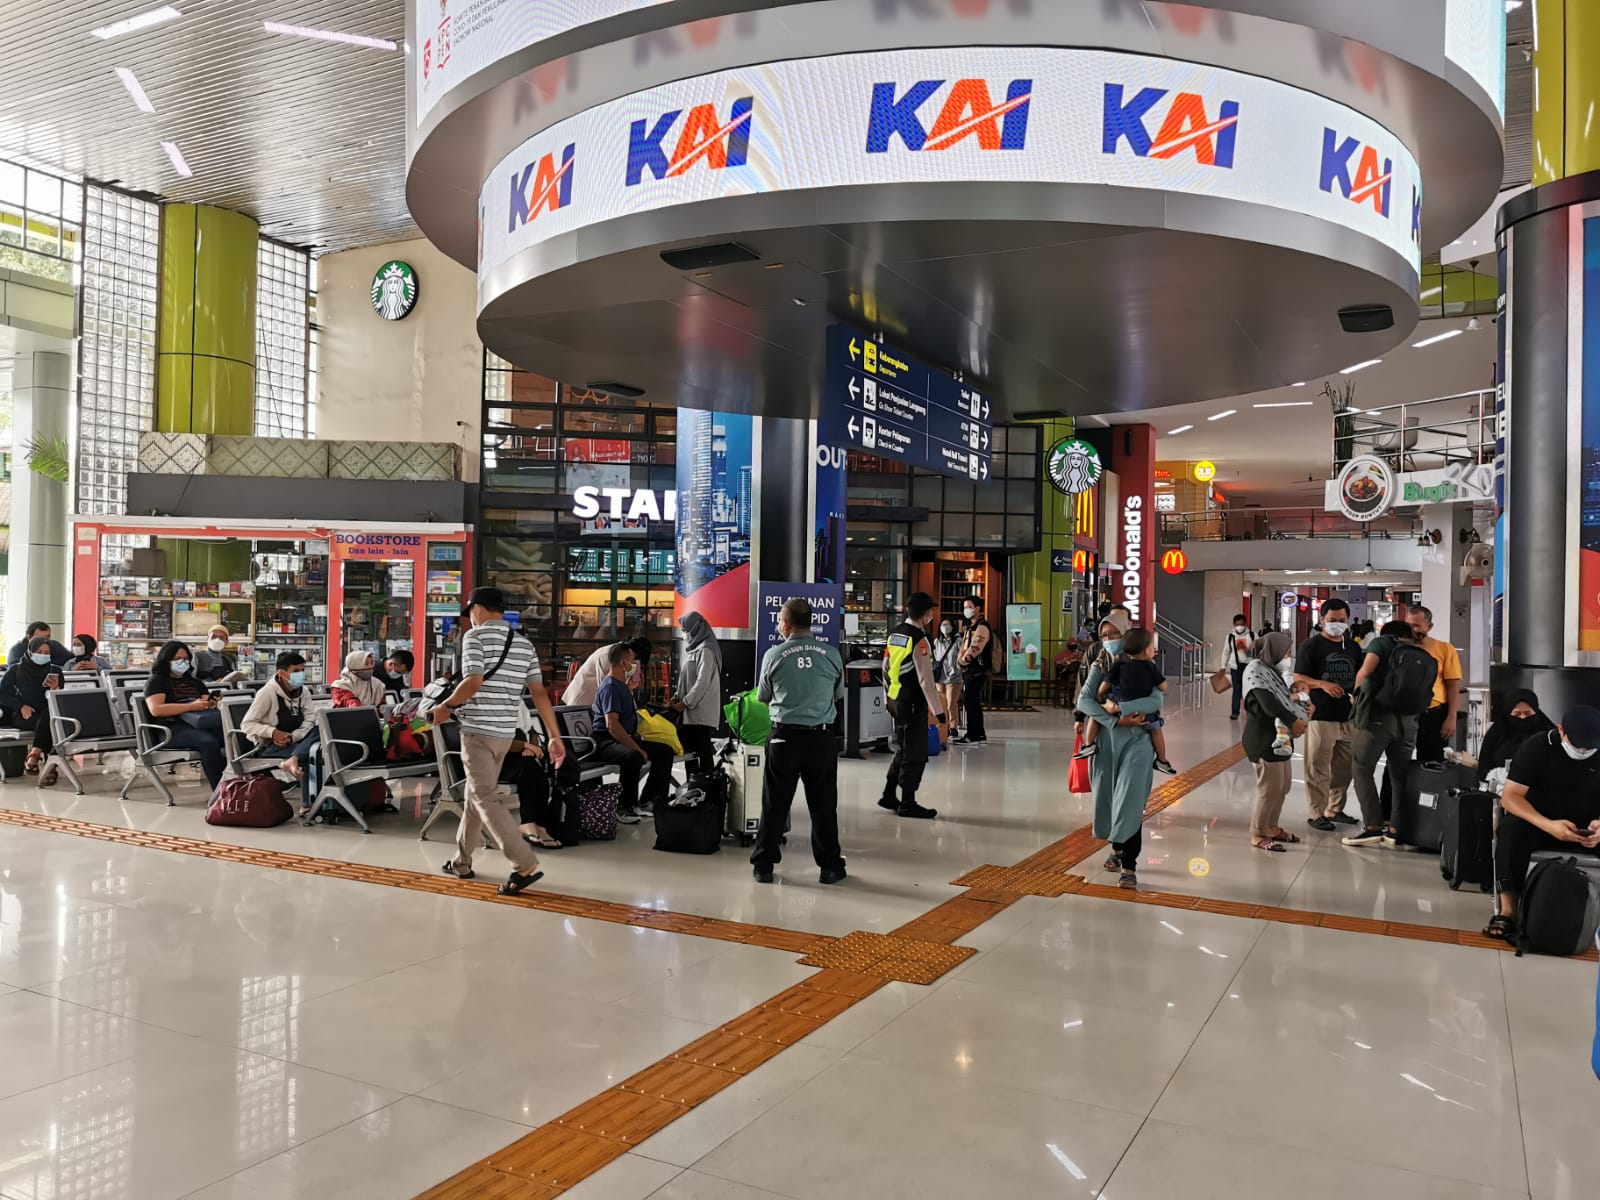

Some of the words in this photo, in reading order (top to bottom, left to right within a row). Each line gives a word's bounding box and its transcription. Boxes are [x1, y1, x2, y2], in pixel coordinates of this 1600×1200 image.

[865, 78, 1033, 154] KAI
[1102, 82, 1239, 169] KAI
[625, 96, 753, 187] KAI
[508, 142, 576, 234] KAI
[1319, 126, 1392, 219] KAI
[1404, 480, 1456, 503] Bugis
[335, 533, 422, 547] BOOKSTORE
[368, 547, 384, 555] lain
[392, 547, 409, 555] lain
[765, 596, 834, 609] PELNAN
[797, 656, 813, 669] 83
